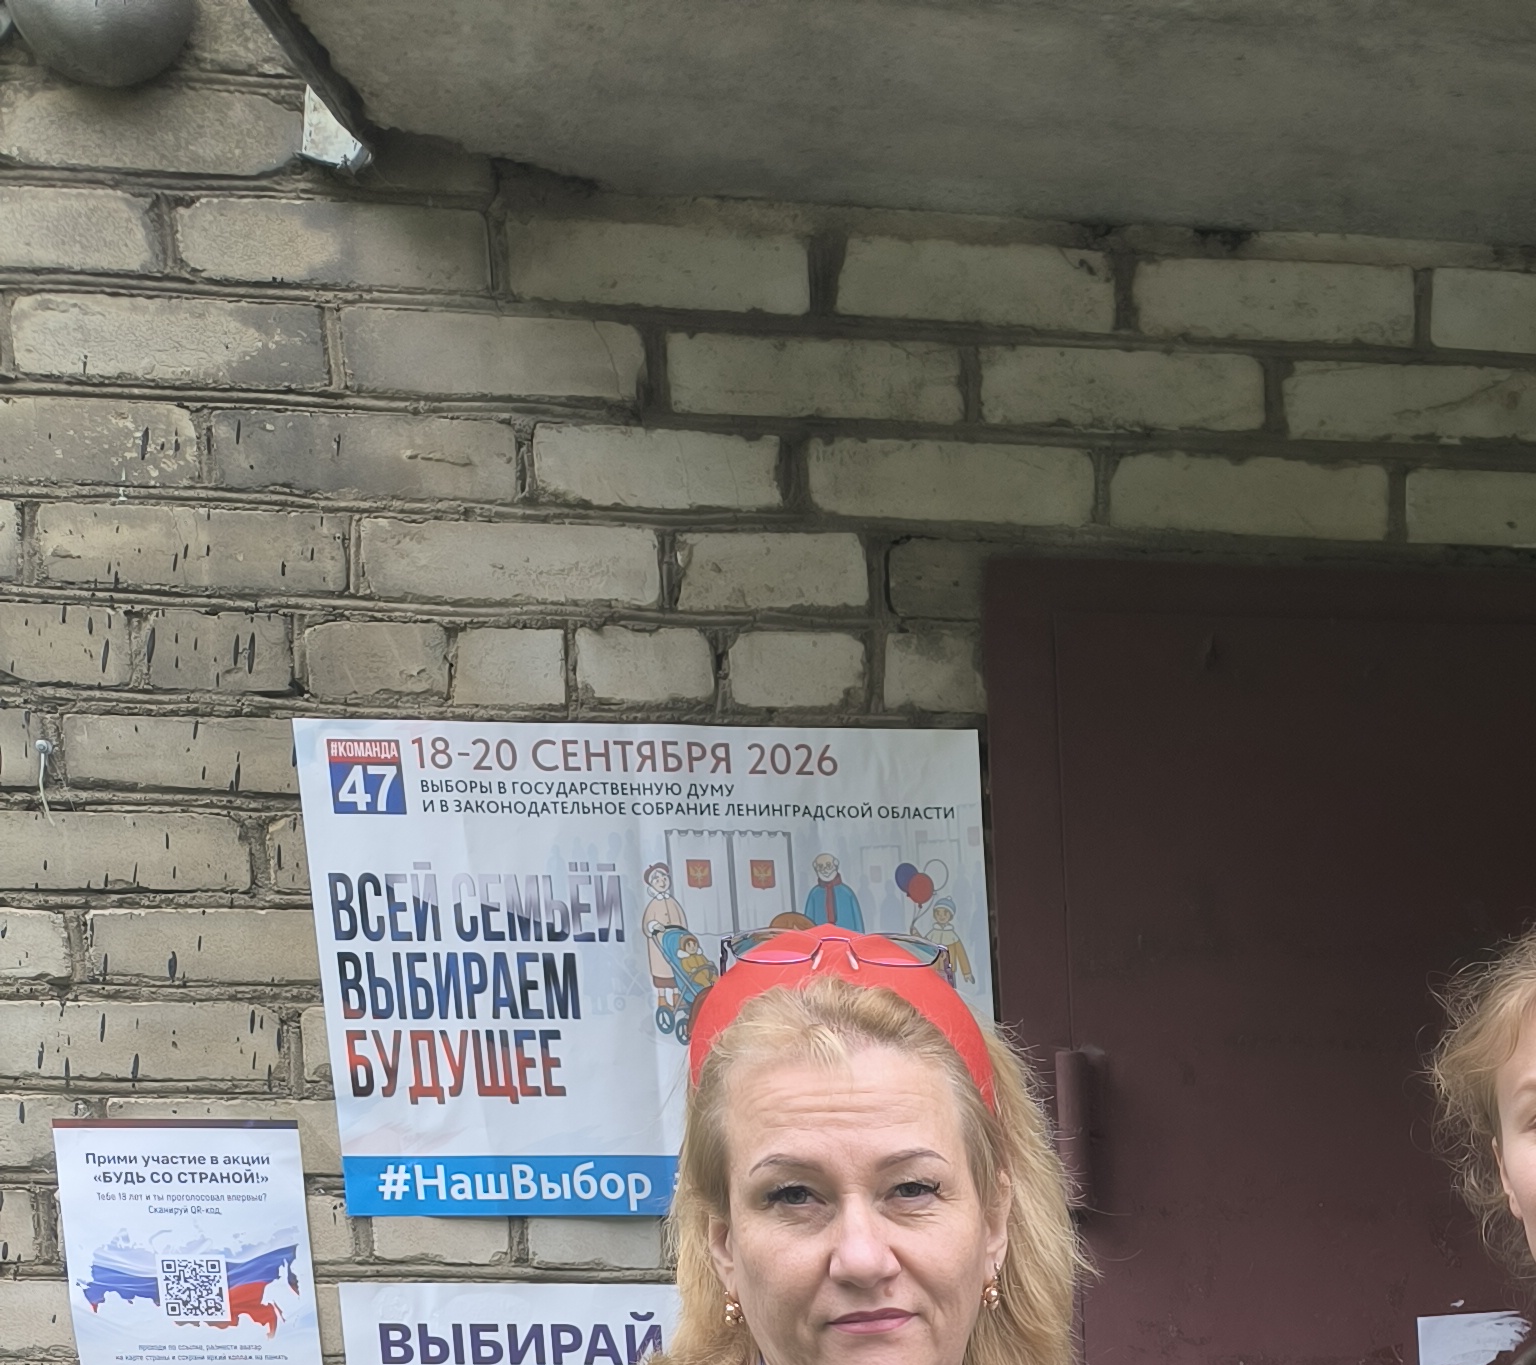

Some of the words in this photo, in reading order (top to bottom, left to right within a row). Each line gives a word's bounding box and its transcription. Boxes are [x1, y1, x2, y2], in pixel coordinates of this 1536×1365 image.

[330, 741, 399, 759] #КОМАНДА
[411, 736, 518, 772] 18-20
[531, 739, 733, 774] СЕНТЯБРЯ
[747, 743, 839, 777] 2026
[338, 765, 398, 812] 47
[420, 779, 493, 795] ВЫБОРЫ
[499, 780, 508, 795] В
[511, 781, 682, 798] ГОСУДАРСТВЕННУЮ
[687, 783, 735, 799] ДУМУ
[422, 799, 435, 813] И
[439, 800, 450, 814] В
[454, 800, 627, 817] ЗАКОНОДАТЕЛЬНОЕ
[631, 802, 721, 816] СОБРАНИЕ
[725, 802, 873, 821] ЛЕНИНГРАДСКОЙ
[877, 805, 956, 820] ОБЛАСТИ
[327, 861, 442, 942] ВСЕЙ
[452, 861, 626, 943] СЕМЬЁЙ
[337, 951, 582, 1021] ВЫБИРАЕМ
[346, 1030, 567, 1105] БУДУЩЕЕ
[85, 1152, 138, 1167] Прими
[141, 1155, 206, 1168] участие
[210, 1155, 220, 1165] в
[222, 1155, 271, 1167] акции
[93, 1171, 147, 1186] «БУДЬ
[150, 1171, 174, 1184] СО
[177, 1168, 270, 1185] СТРАНОЙ!»
[377, 1161, 653, 1211] #НашВыбор
[148, 1205, 189, 1215] Сканируй
